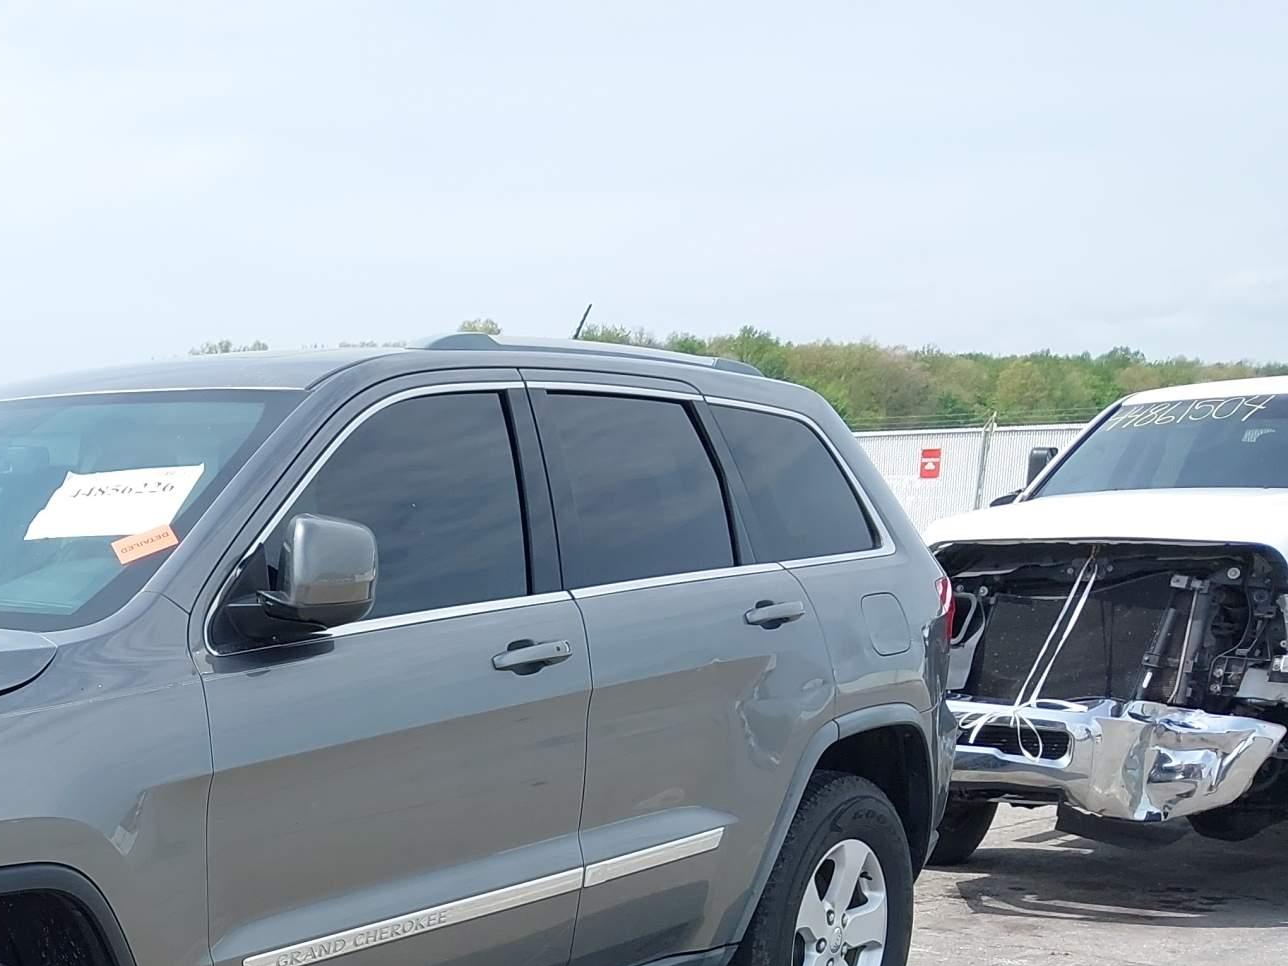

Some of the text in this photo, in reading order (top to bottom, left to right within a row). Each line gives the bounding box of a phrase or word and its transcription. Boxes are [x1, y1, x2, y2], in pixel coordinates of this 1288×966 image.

[1107, 394, 1276, 432] 44861504
[119, 531, 171, 555] DETAILED
[352, 909, 449, 949] CHEROKEE
